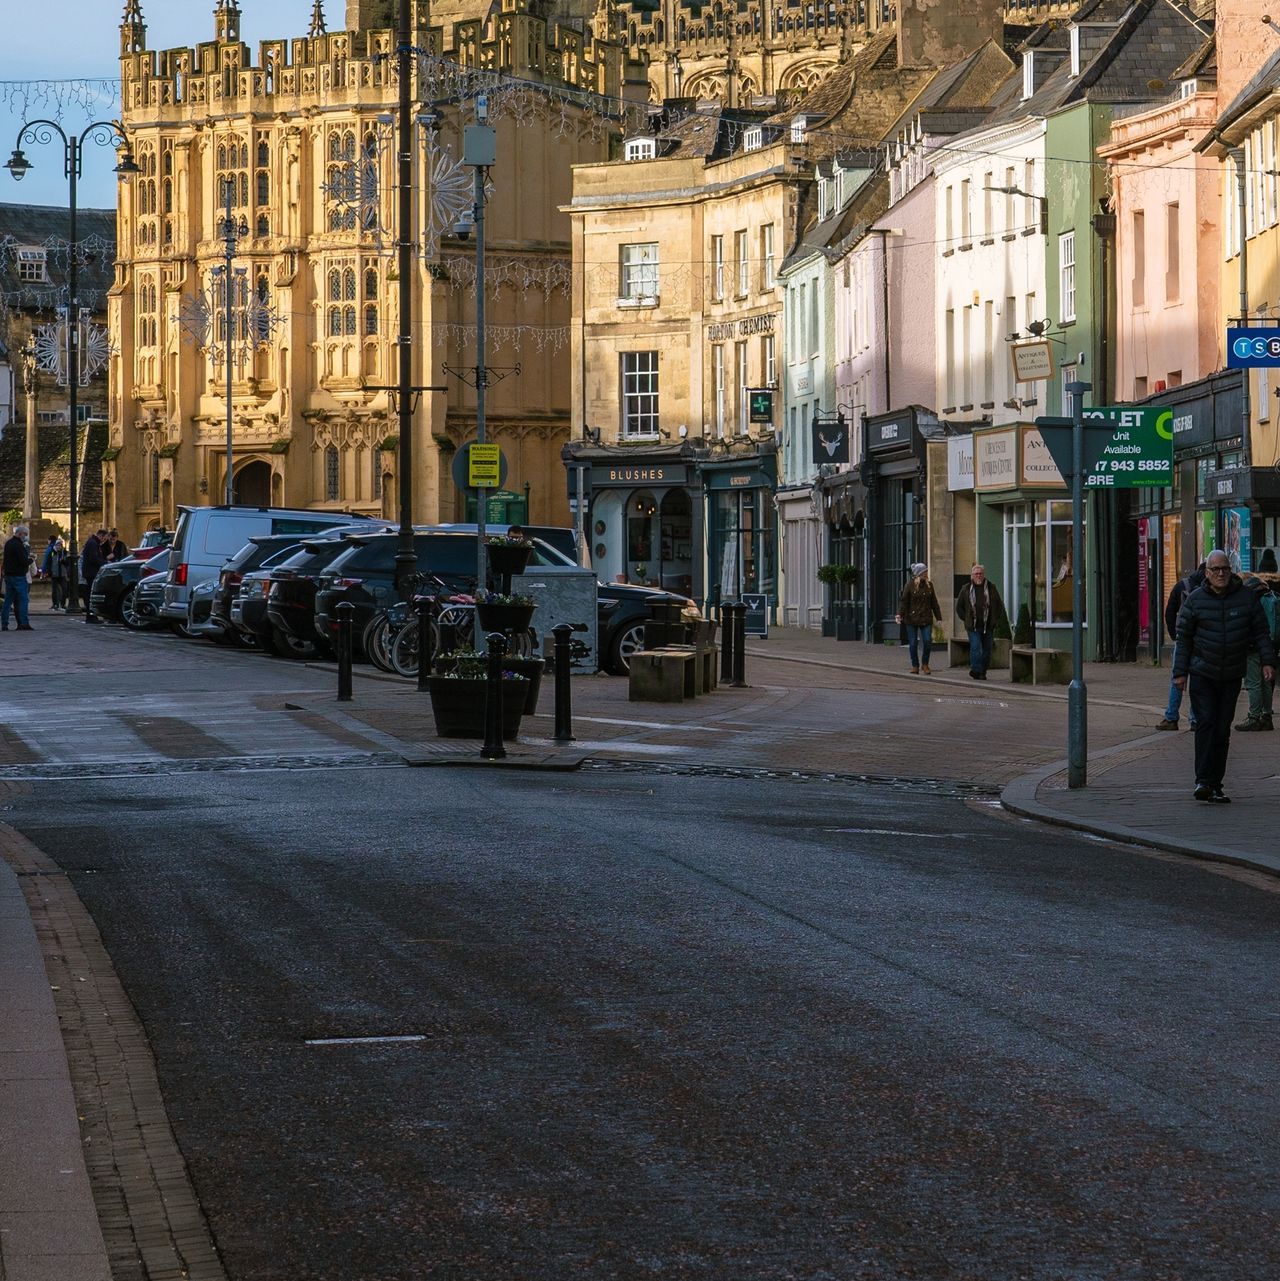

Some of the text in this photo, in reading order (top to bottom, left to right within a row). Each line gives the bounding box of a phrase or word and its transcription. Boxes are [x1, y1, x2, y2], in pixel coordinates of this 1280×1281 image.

[1239, 341, 1280, 354] TSB
[1104, 445, 1142, 454] Available
[1110, 460, 1135, 471] 943
[1137, 460, 1170, 471] 5852
[610, 469, 664, 480] BLUSHES
[1085, 474, 1114, 486] BRE
